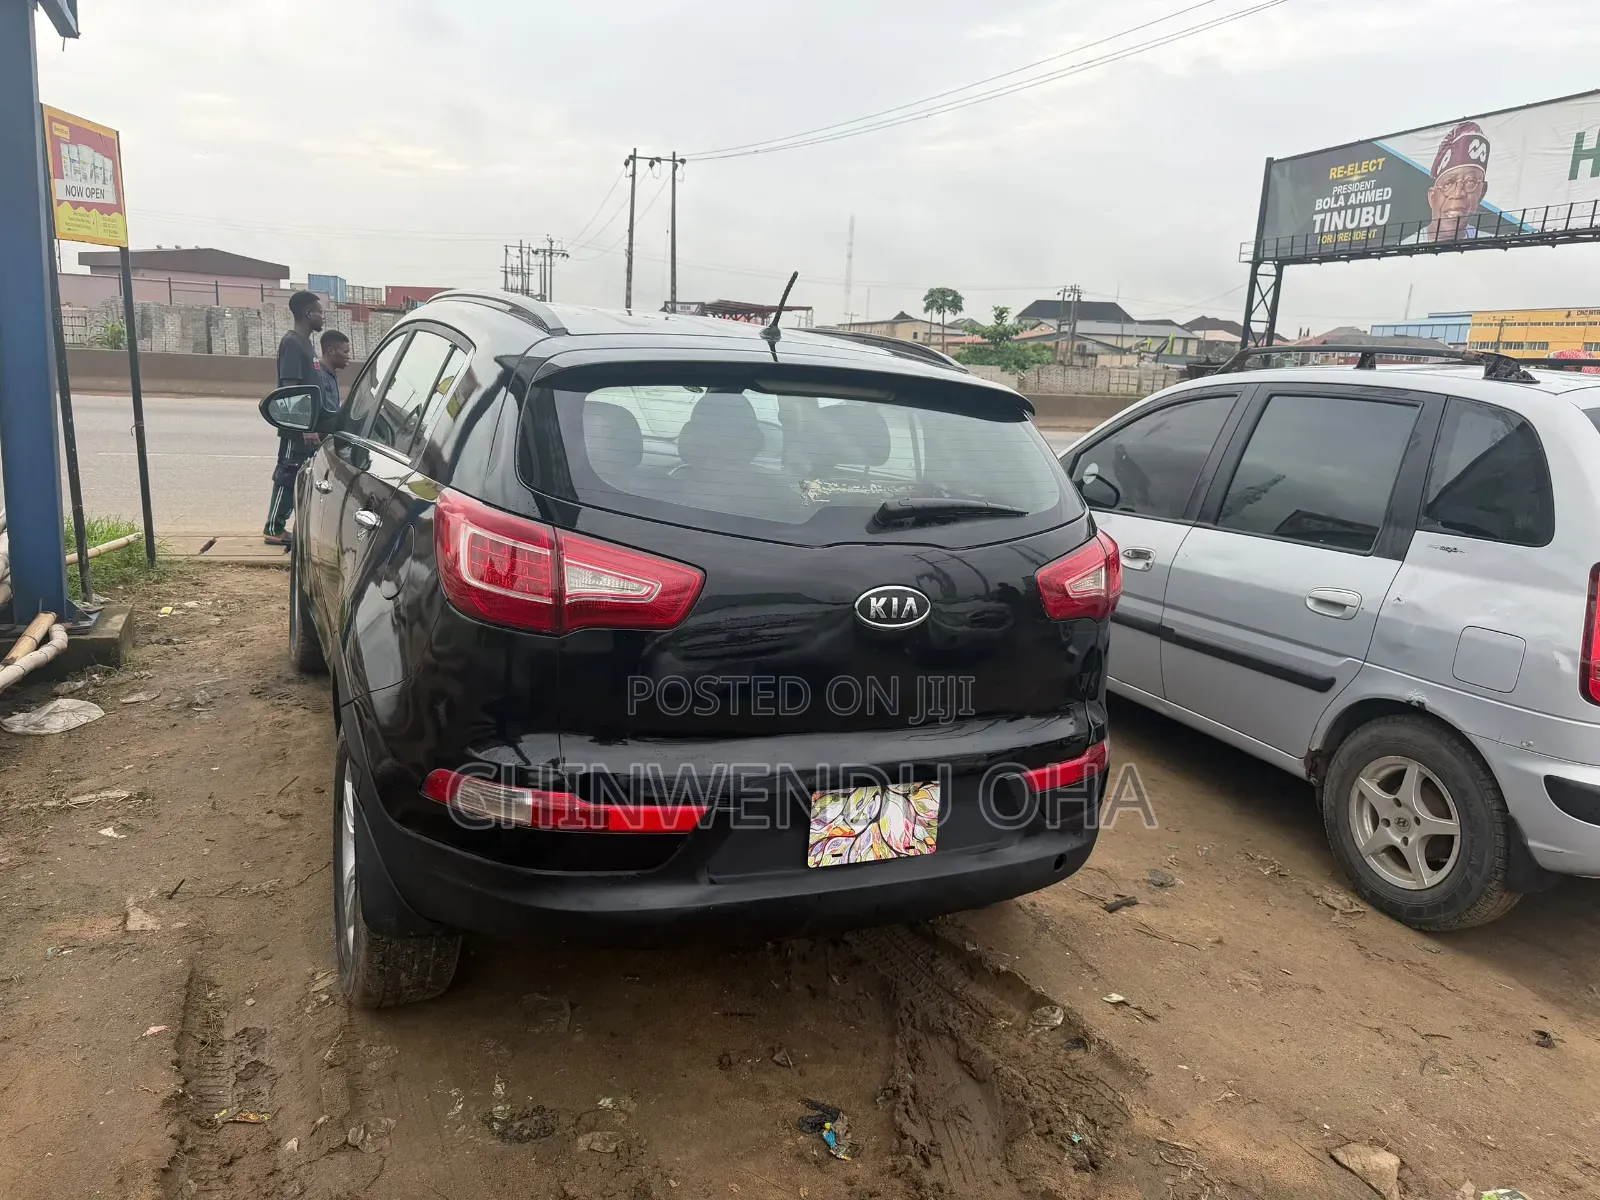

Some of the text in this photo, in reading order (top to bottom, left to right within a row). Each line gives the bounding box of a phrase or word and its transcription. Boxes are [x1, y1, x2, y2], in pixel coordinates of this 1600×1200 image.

[1329, 157, 1385, 179] RE-ELECT
[65, 184, 105, 199] NOW OPEN
[1332, 180, 1376, 195] PRESIDENT
[1315, 187, 1392, 211] BOLA AHMED
[1313, 203, 1391, 233] TINUBU
[869, 597, 918, 619] KIA
